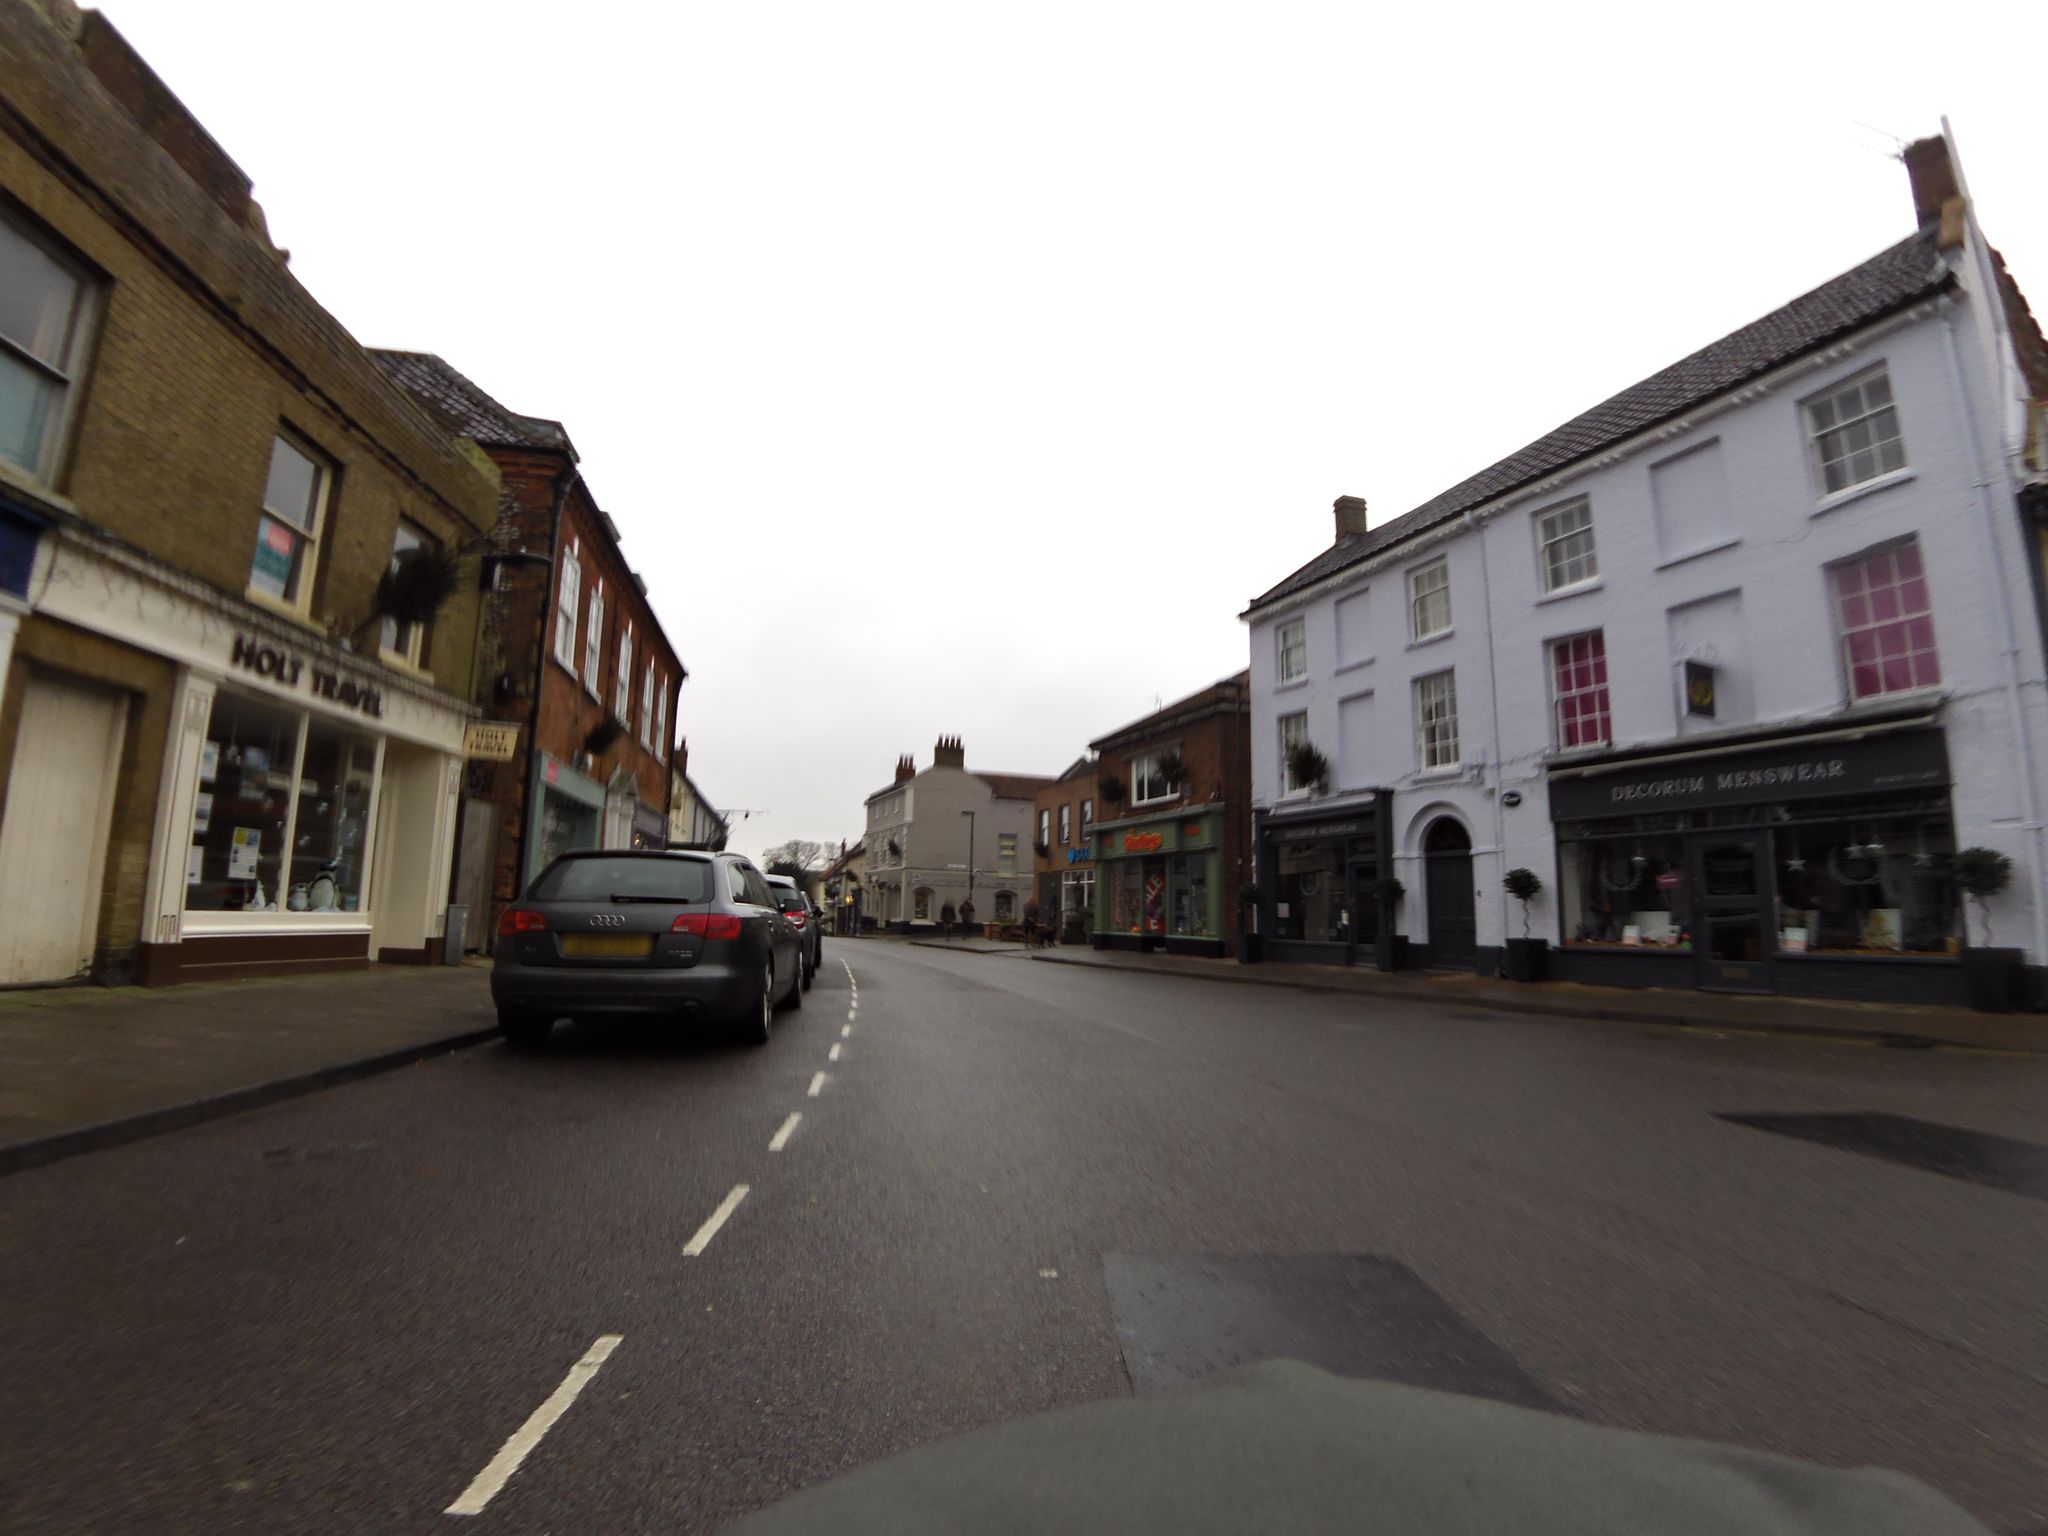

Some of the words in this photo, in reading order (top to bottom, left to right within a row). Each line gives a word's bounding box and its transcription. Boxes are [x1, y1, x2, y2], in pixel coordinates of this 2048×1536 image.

[231, 632, 303, 687] HOLT
[310, 665, 382, 718] TRAVEL
[1611, 776, 1705, 801] DECORUM
[1716, 759, 1846, 791] MENSWEAR
